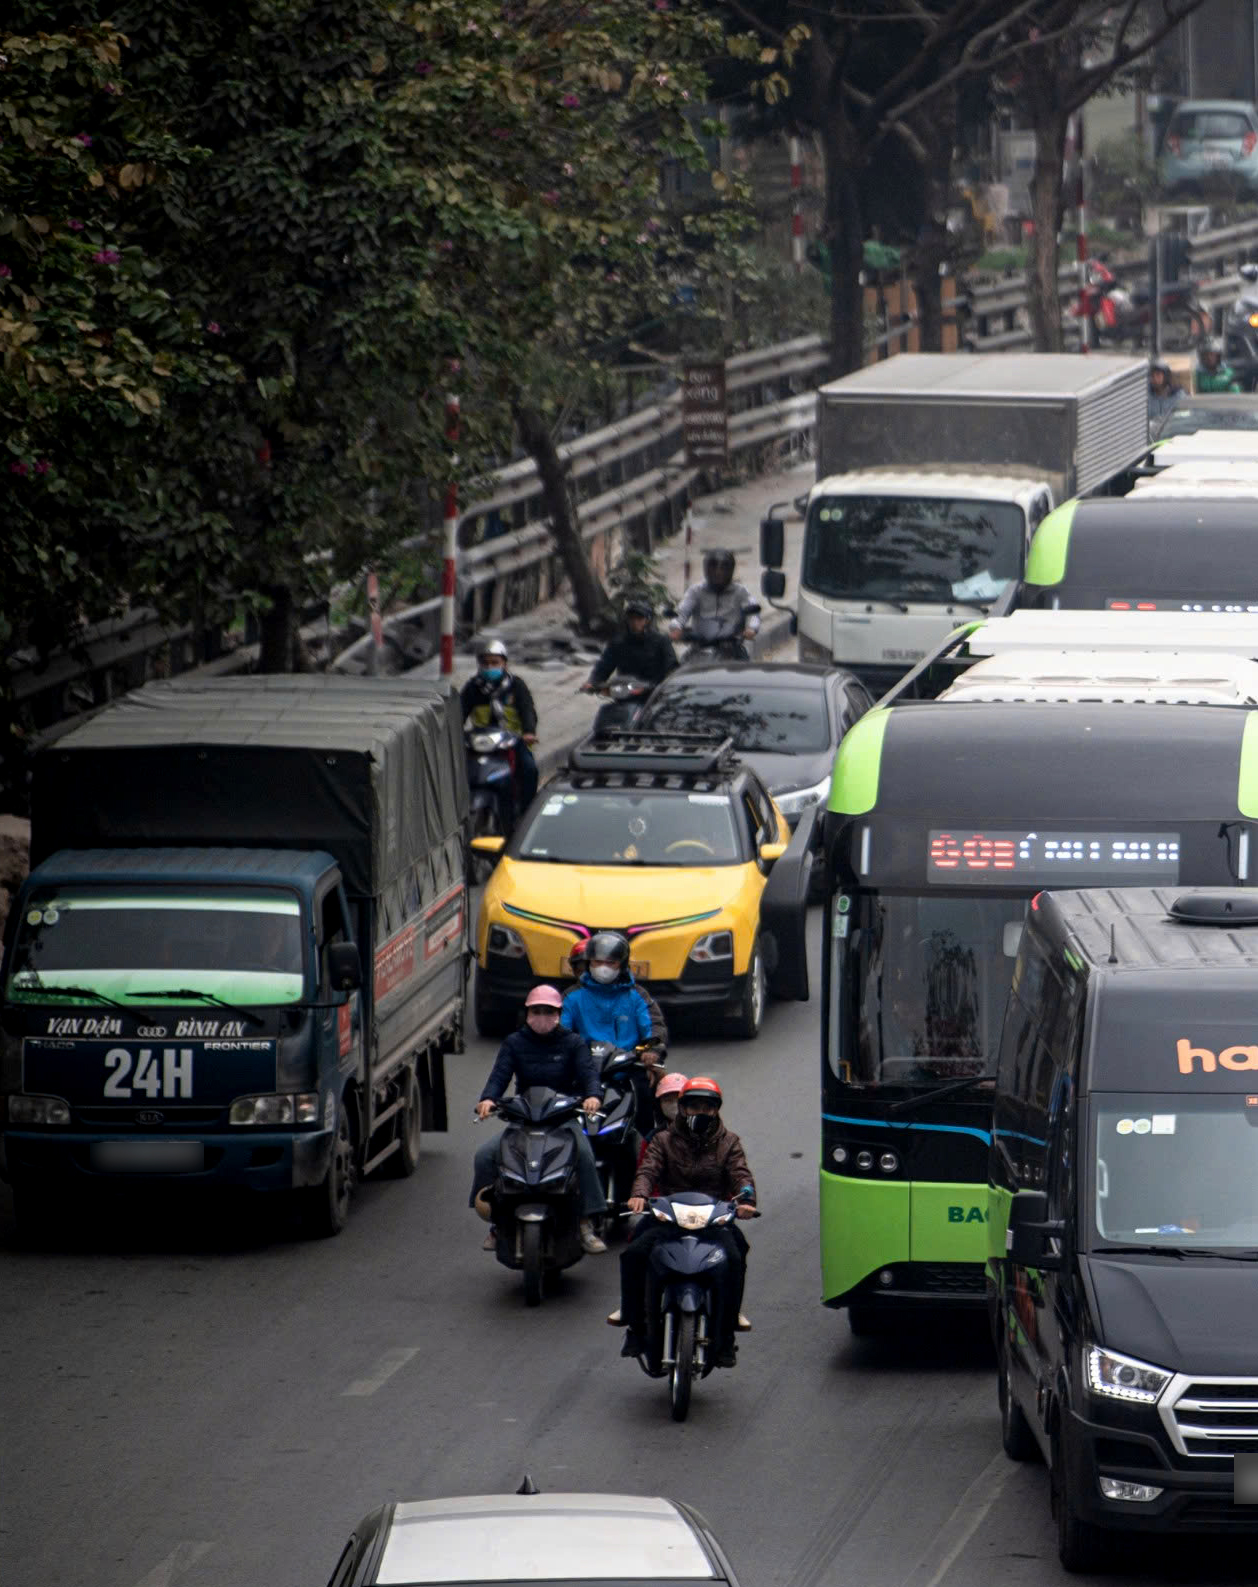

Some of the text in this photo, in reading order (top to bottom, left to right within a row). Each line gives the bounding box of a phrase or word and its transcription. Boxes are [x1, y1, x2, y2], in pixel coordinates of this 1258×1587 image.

[47, 1017, 83, 1036] VẠN
[175, 1017, 222, 1037] BÌNH
[219, 1021, 248, 1037] AN
[204, 1041, 271, 1050] FRONTIER
[103, 1048, 193, 1098] 24H
